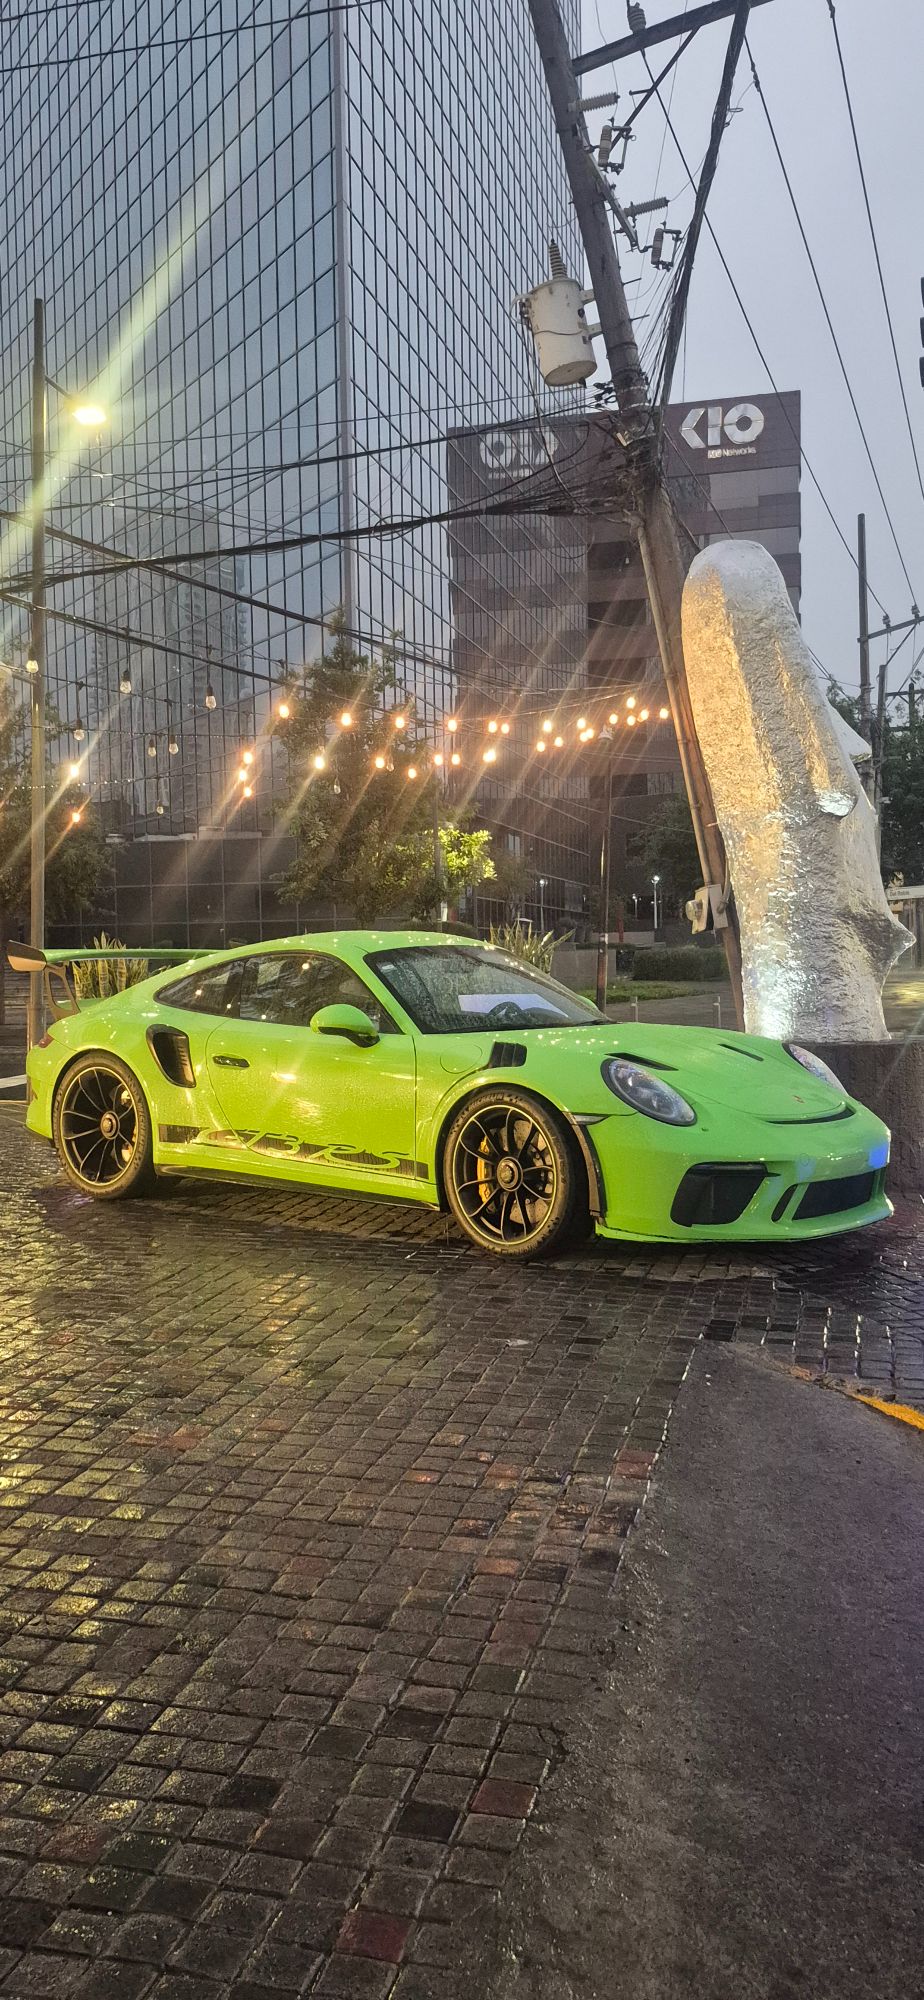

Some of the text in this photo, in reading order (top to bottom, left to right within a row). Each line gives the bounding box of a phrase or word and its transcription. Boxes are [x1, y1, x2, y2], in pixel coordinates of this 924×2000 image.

[680, 403, 764, 448] KIO
[723, 446, 757, 457] Networks
[193, 1128, 410, 1169] GT3 RS
